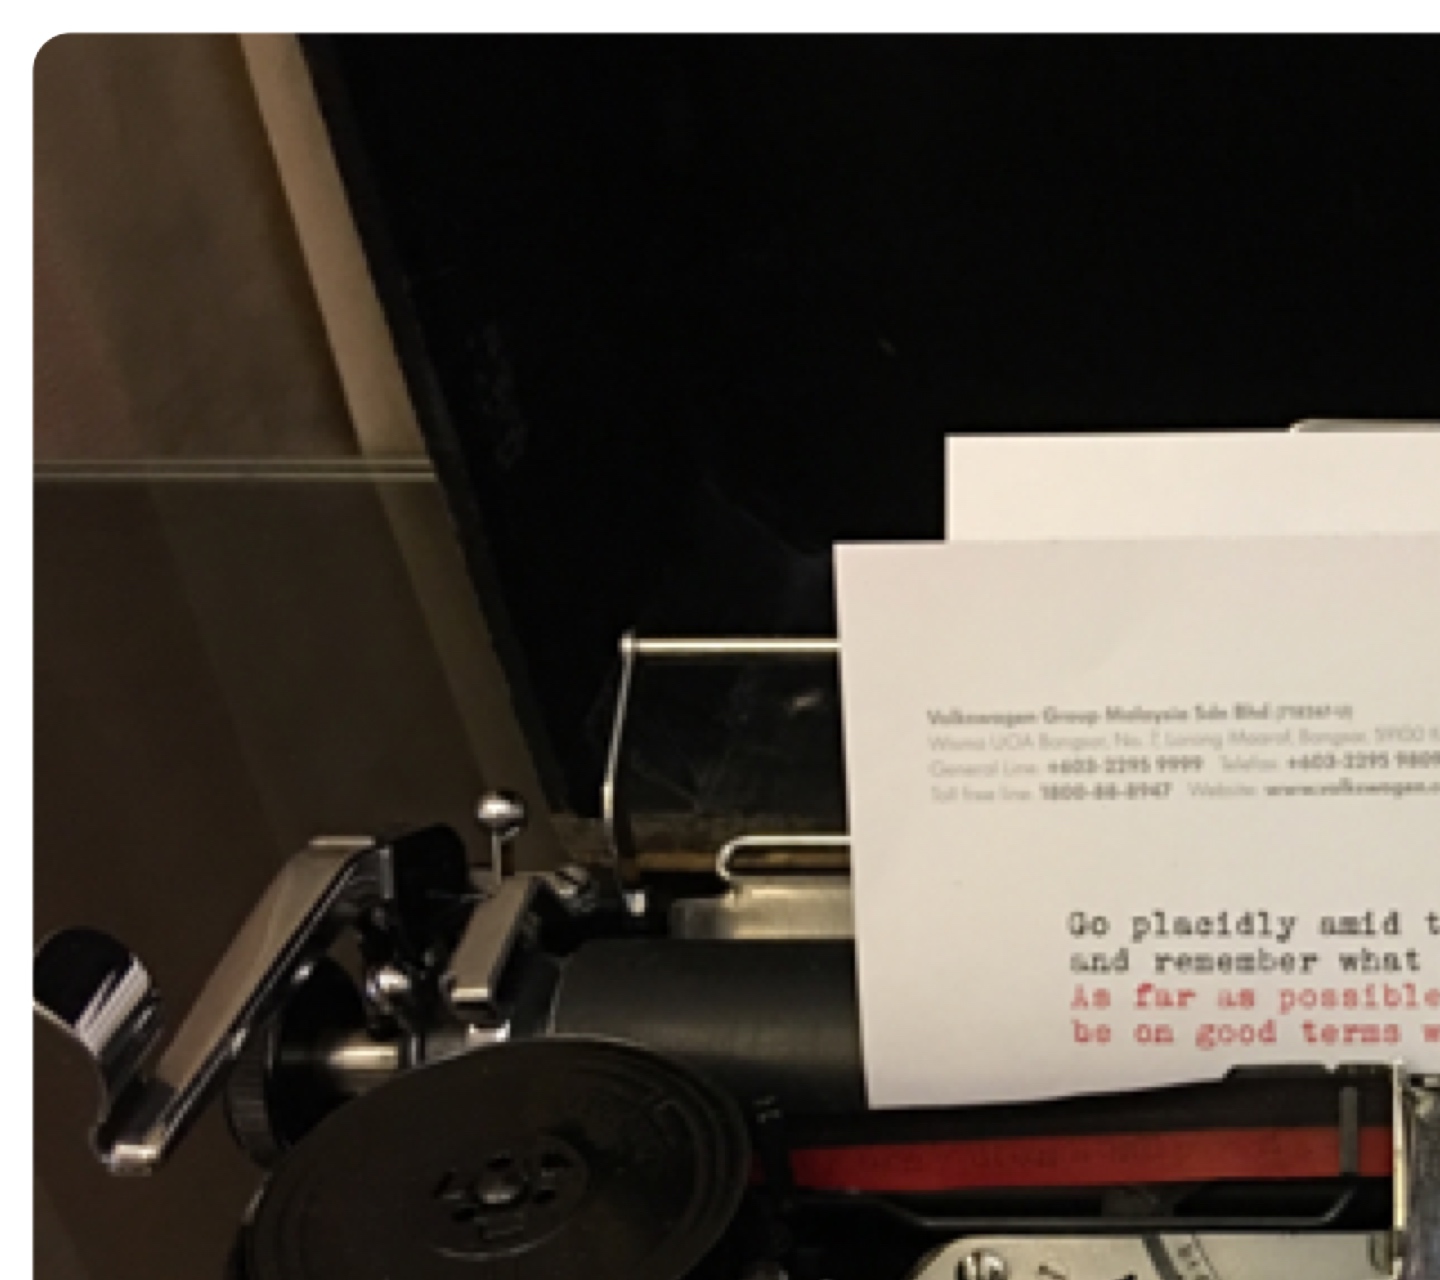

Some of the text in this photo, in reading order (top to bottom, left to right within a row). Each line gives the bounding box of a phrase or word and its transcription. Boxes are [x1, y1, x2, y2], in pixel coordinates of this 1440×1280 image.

[926, 706, 1036, 727] Volkswagen
[1041, 704, 1098, 726] Group
[1105, 703, 1187, 723] Malaysia
[1194, 702, 1226, 720] Sdn
[1234, 700, 1269, 720] Bhd
[1068, 911, 1111, 936] Go
[1130, 911, 1299, 943] placidly
[1320, 911, 1402, 936] amid
[1069, 948, 1130, 973] and
[1154, 948, 1321, 975] remember
[1337, 948, 1420, 973] what
[1070, 984, 1112, 1009] As
[1133, 982, 1197, 1009] far
[1217, 987, 1256, 1009] as
[1071, 1019, 1112, 1045] be
[1133, 1023, 1174, 1046] on
[1195, 1018, 1277, 1050] good
[1302, 1018, 1402, 1046] terms
